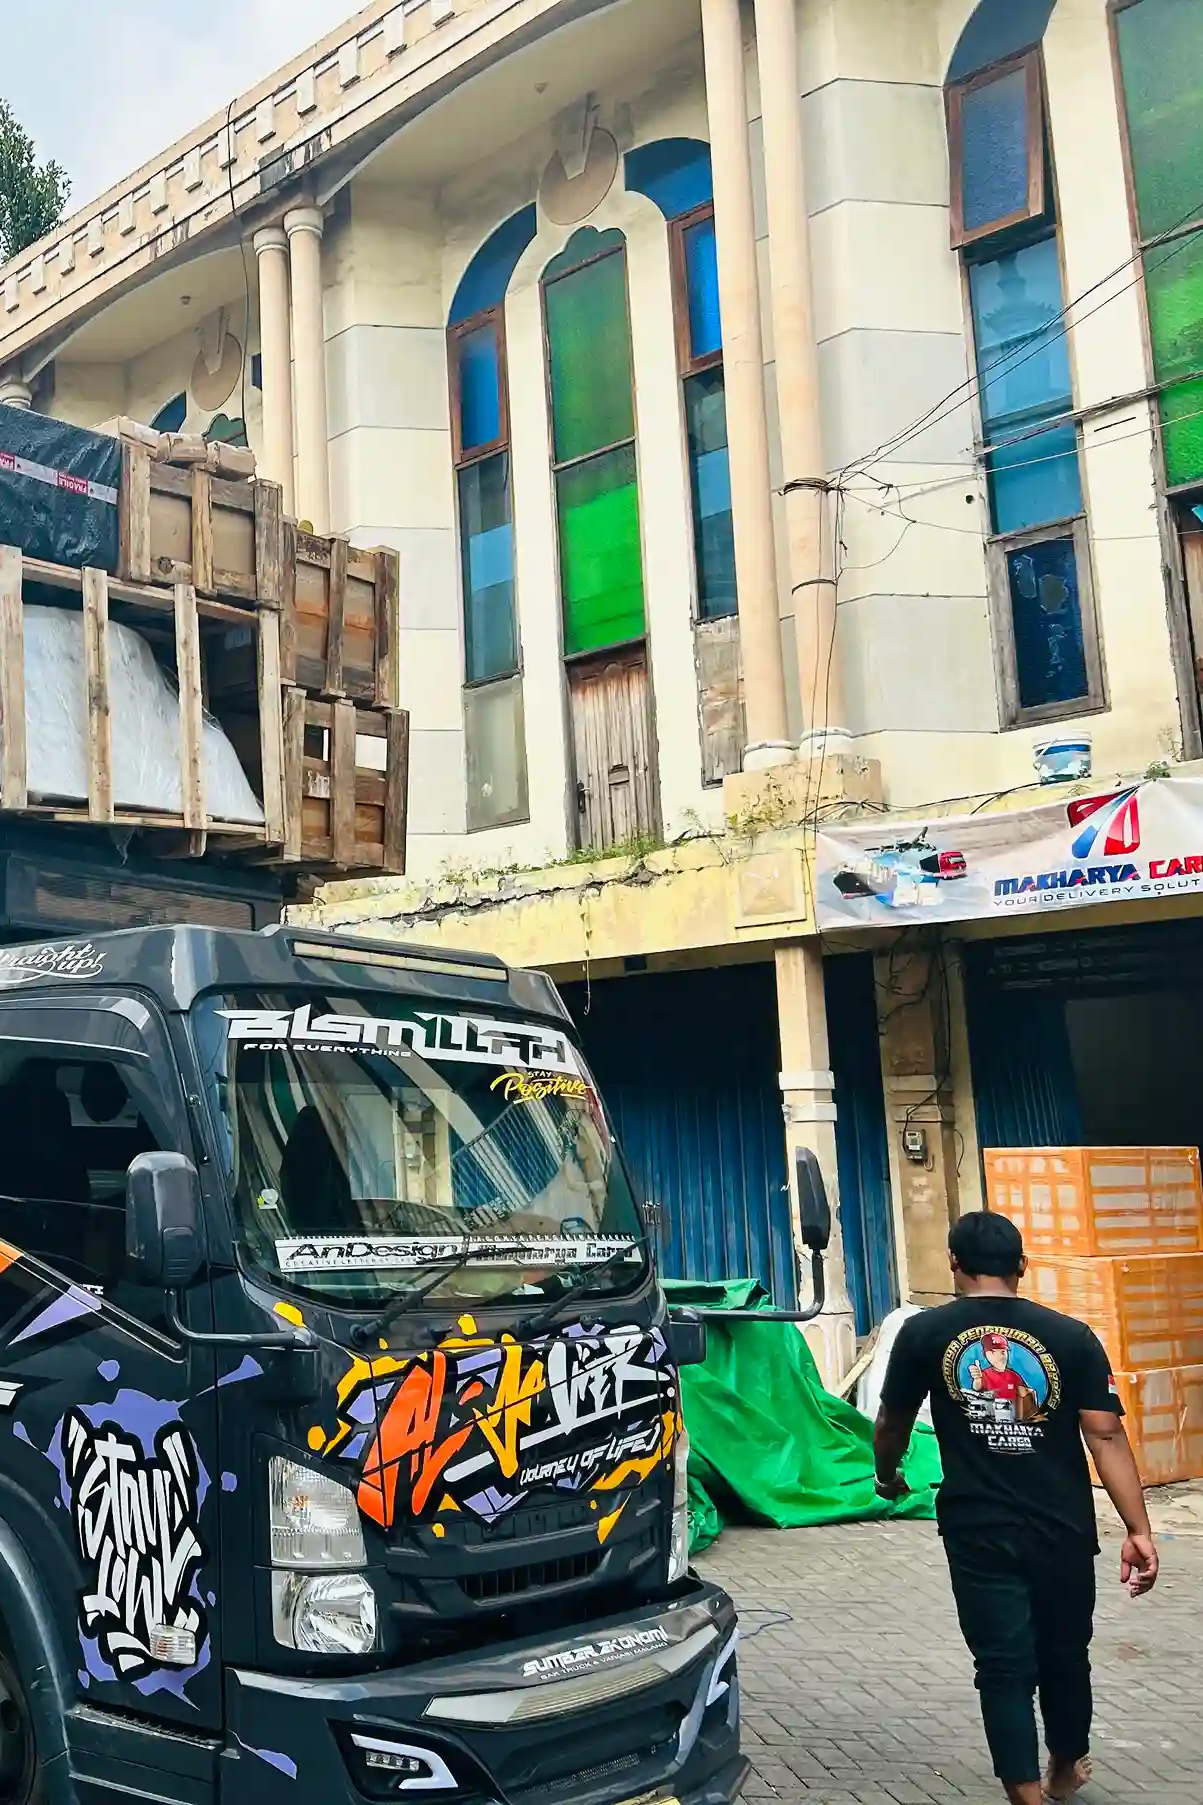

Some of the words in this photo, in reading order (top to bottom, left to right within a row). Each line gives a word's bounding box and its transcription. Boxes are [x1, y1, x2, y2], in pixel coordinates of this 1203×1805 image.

[58, 477, 88, 493] FRAGILE
[994, 864, 1141, 896] MAKHARYA
[993, 896, 1038, 907] YOUR
[1044, 886, 1135, 902] DELIVERY
[243, 1042, 292, 1050] FOR
[293, 1044, 412, 1058] EVERYTHING
[527, 1070, 552, 1078] STAY
[286, 1242, 458, 1261] AnDesign
[970, 1423, 1045, 1437] MAKHARYA
